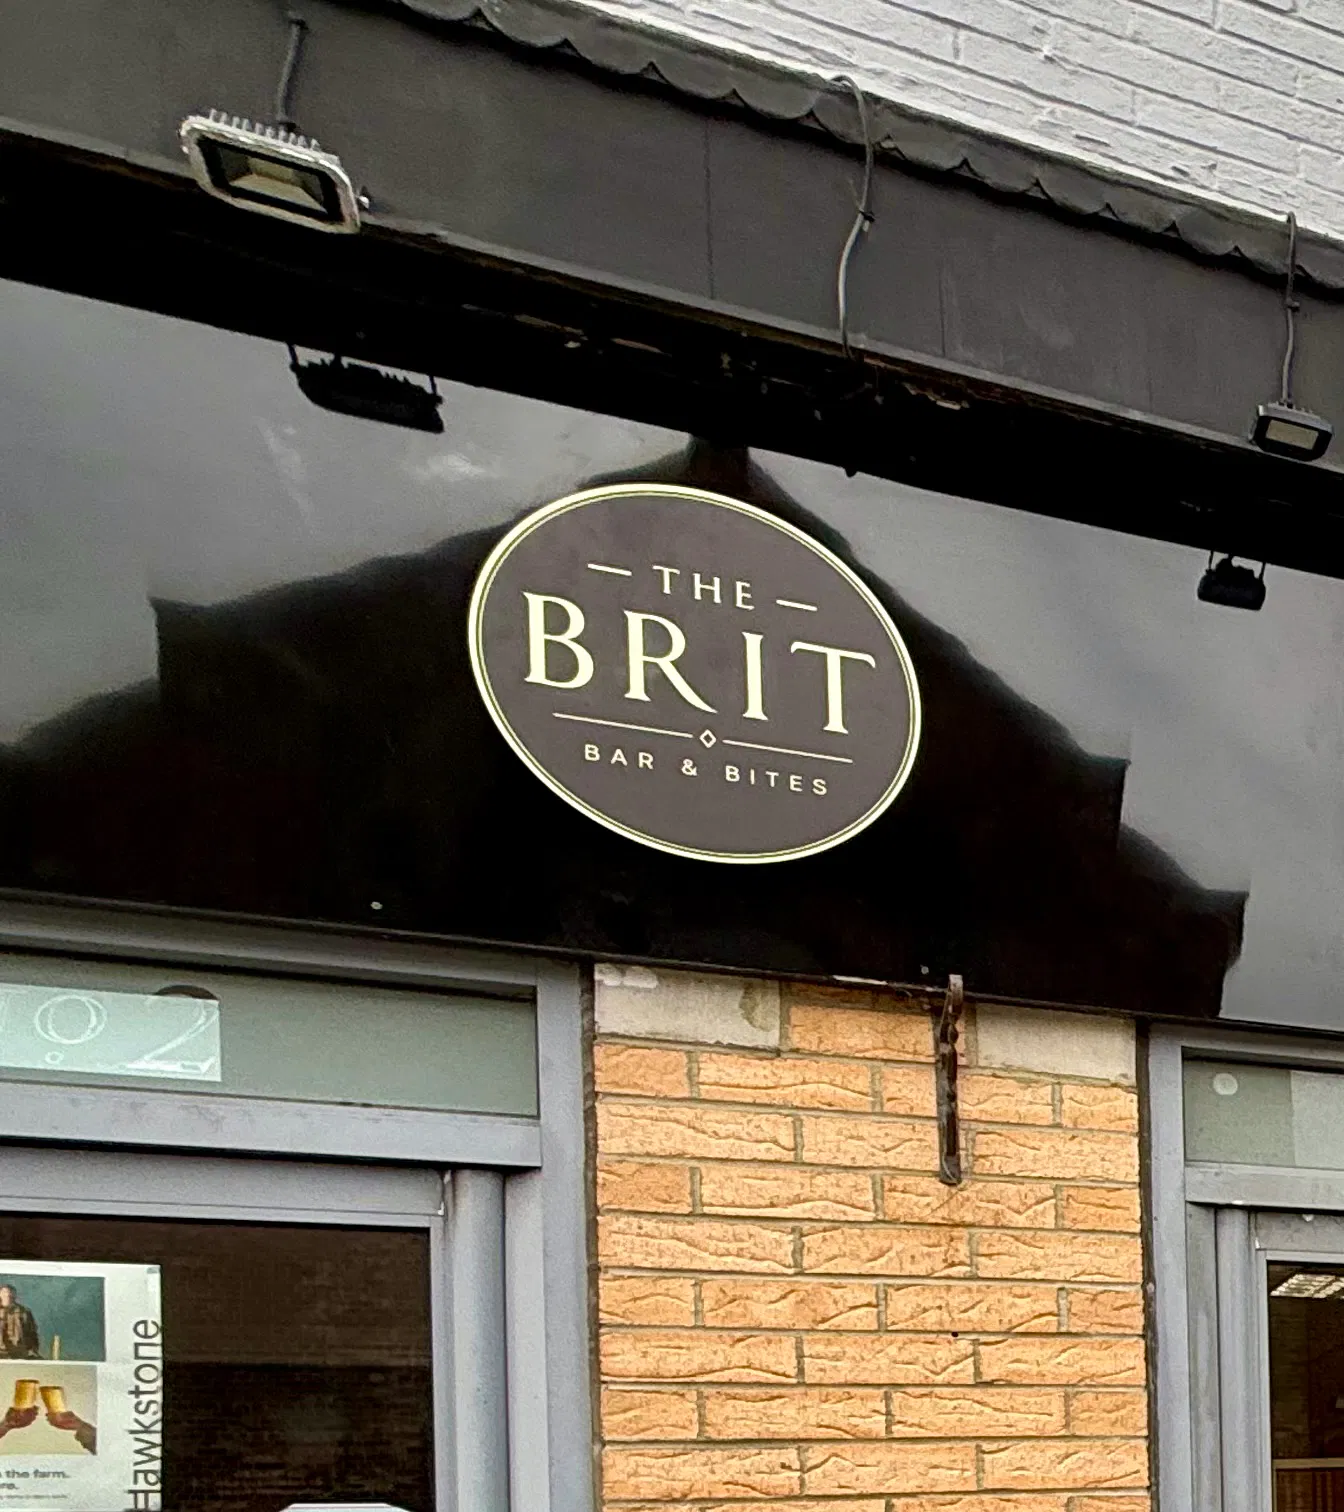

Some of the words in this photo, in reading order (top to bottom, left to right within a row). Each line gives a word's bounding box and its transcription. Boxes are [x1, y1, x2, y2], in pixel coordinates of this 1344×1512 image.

[652, 564, 756, 611] THE
[522, 590, 877, 735] BRIT
[583, 743, 655, 771] BAR
[681, 757, 699, 777] &
[724, 765, 829, 796] BITES
